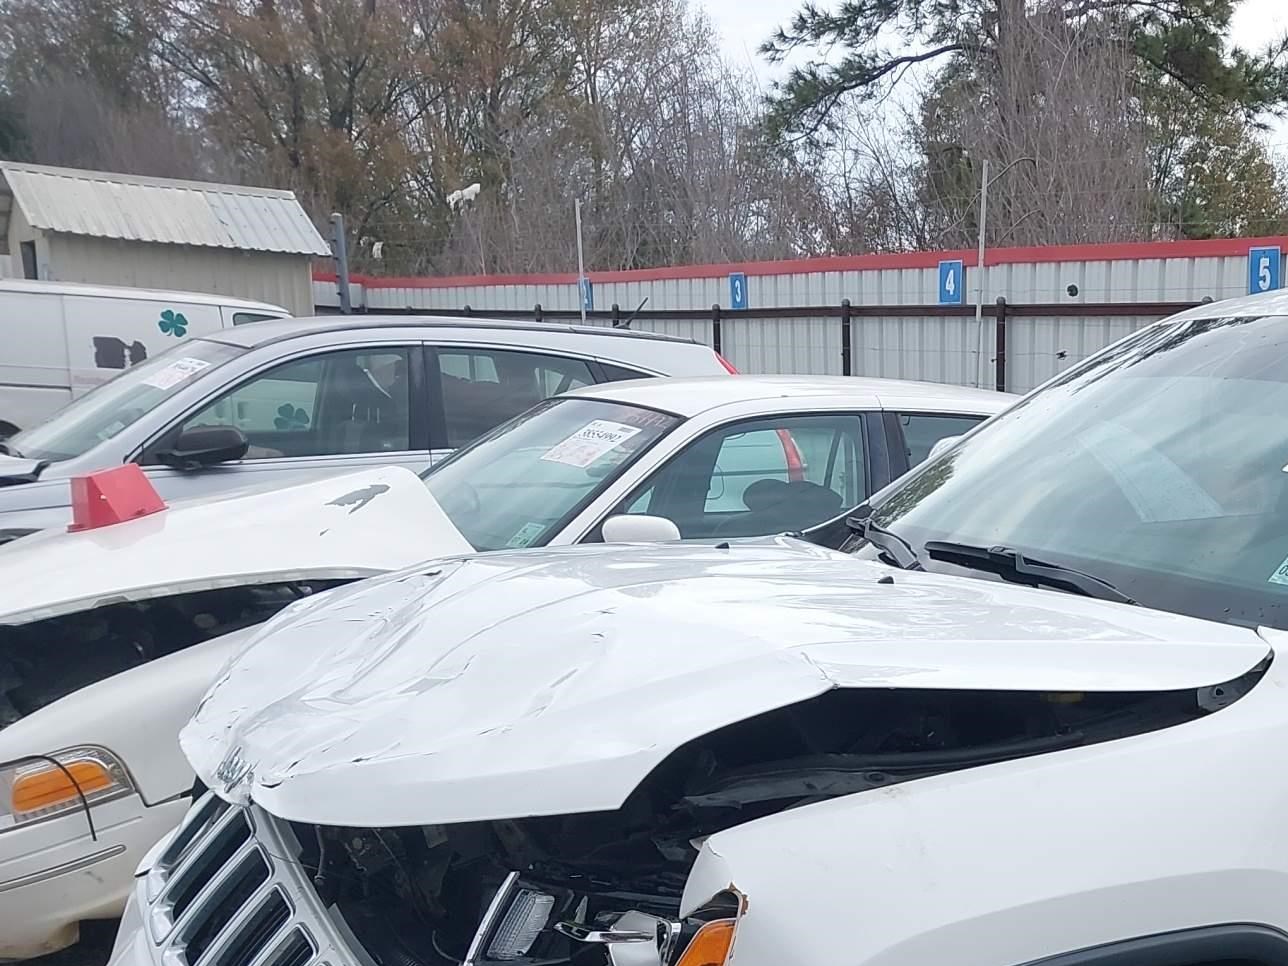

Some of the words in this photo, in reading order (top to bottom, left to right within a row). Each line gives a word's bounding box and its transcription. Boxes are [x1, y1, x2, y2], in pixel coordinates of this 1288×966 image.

[945, 269, 955, 295] 4
[1259, 257, 1271, 290] 5
[735, 279, 741, 303] 3
